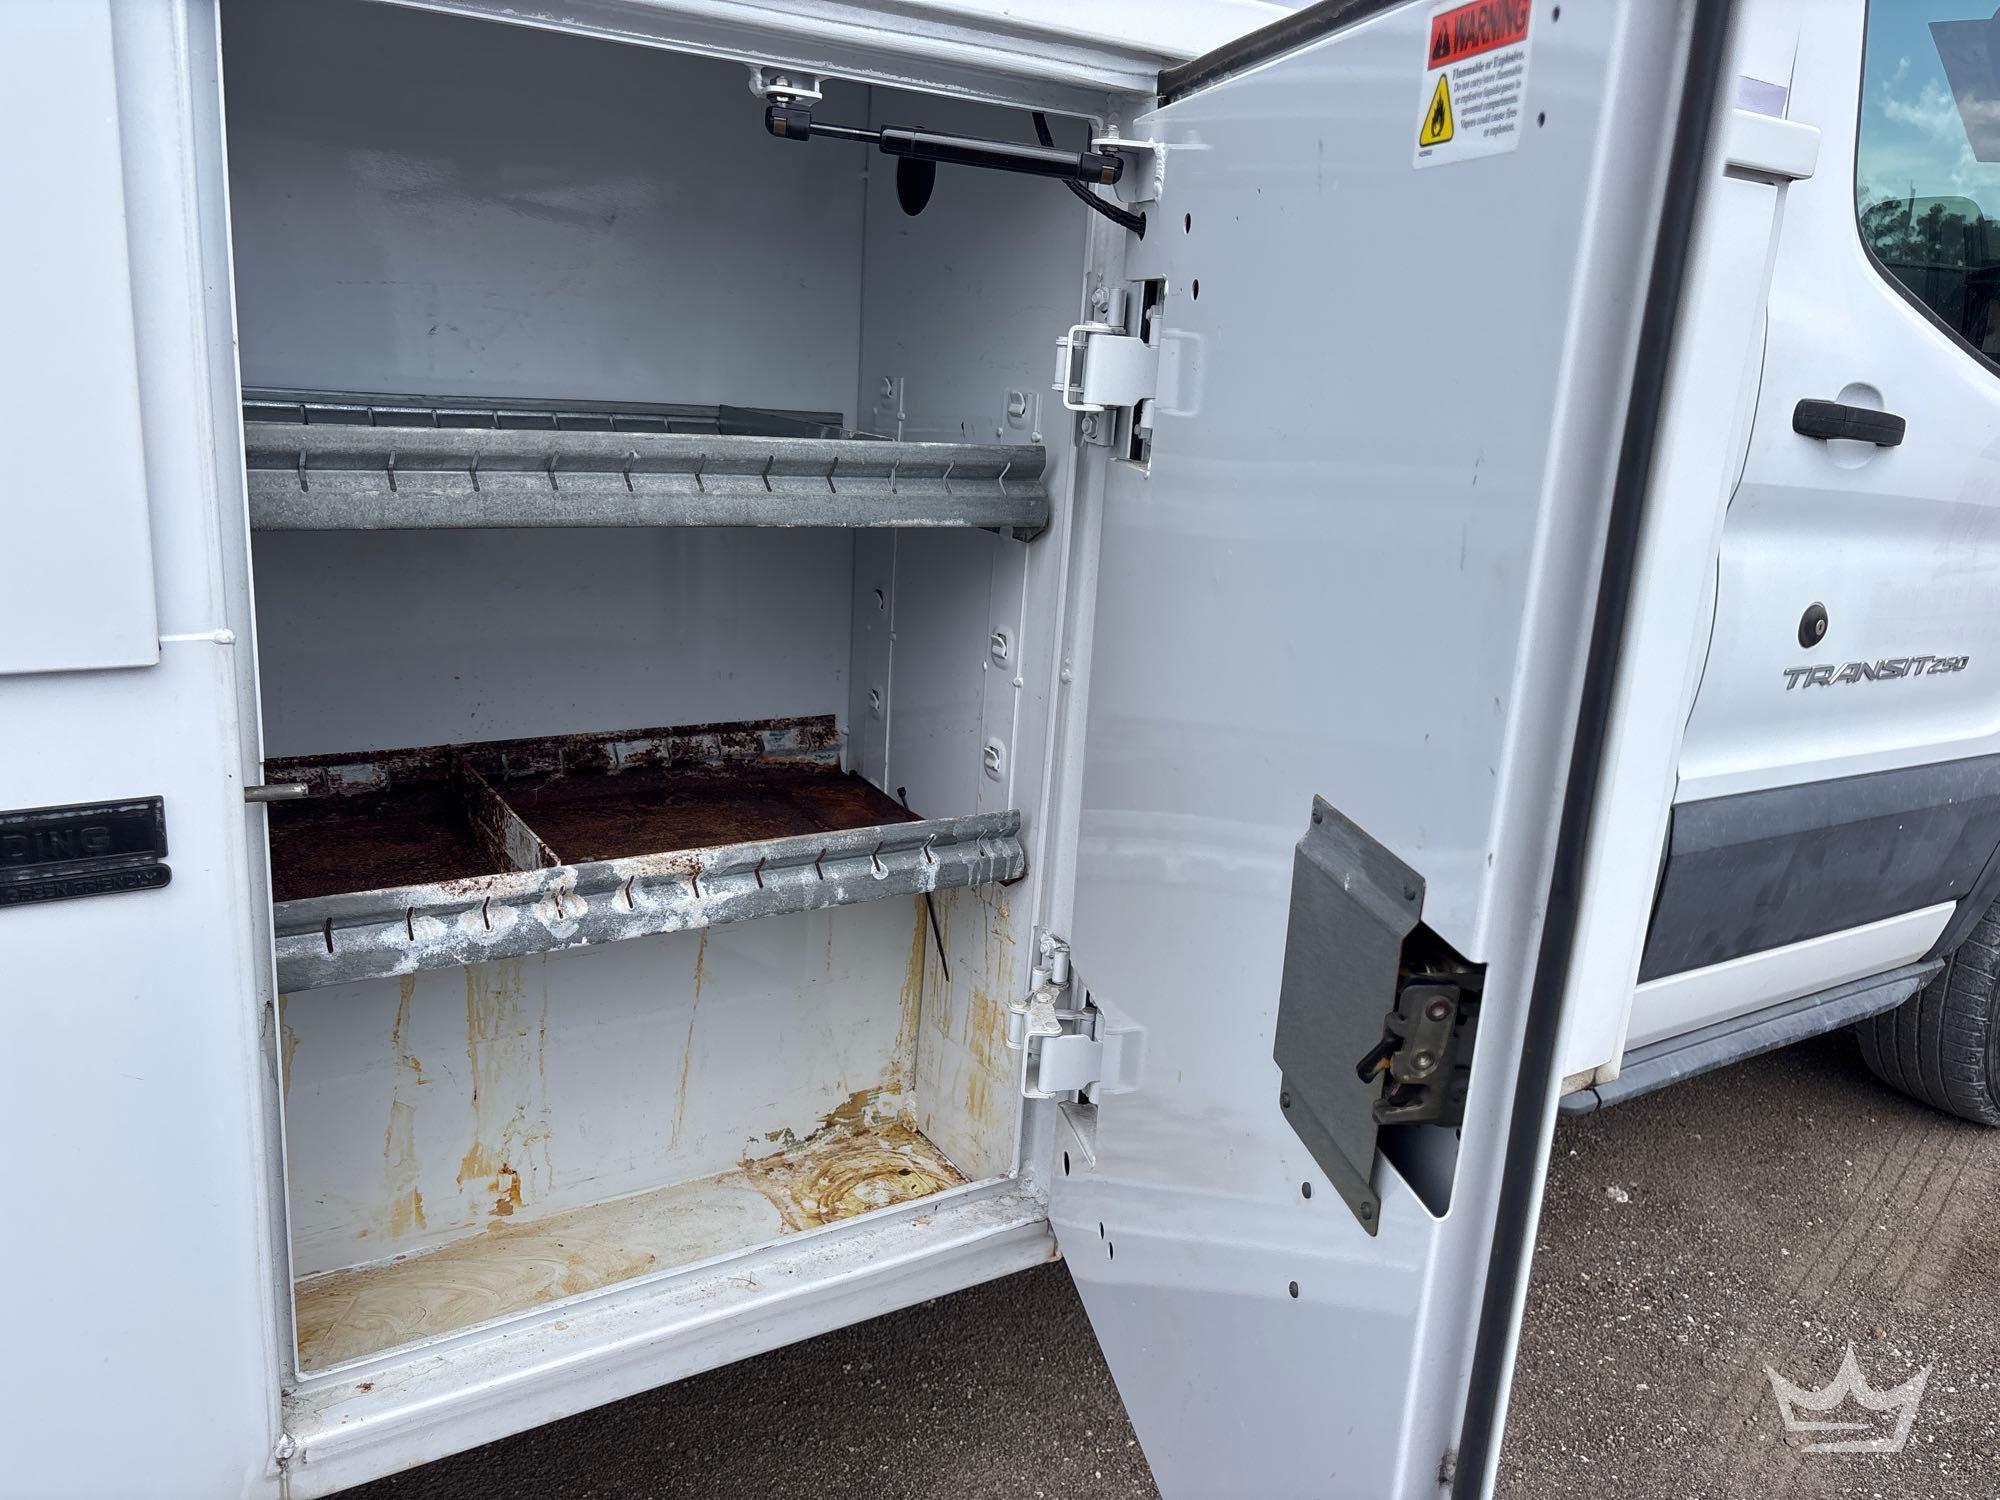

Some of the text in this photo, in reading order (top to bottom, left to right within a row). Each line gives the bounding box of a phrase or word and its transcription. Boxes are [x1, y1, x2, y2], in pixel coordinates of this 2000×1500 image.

[1454, 0, 1528, 54] WARNING
[1453, 62, 1483, 80] Flammable
[1485, 61, 1492, 71] or
[1454, 81, 1461, 92] Do
[1784, 656, 1935, 690] TRANSIT
